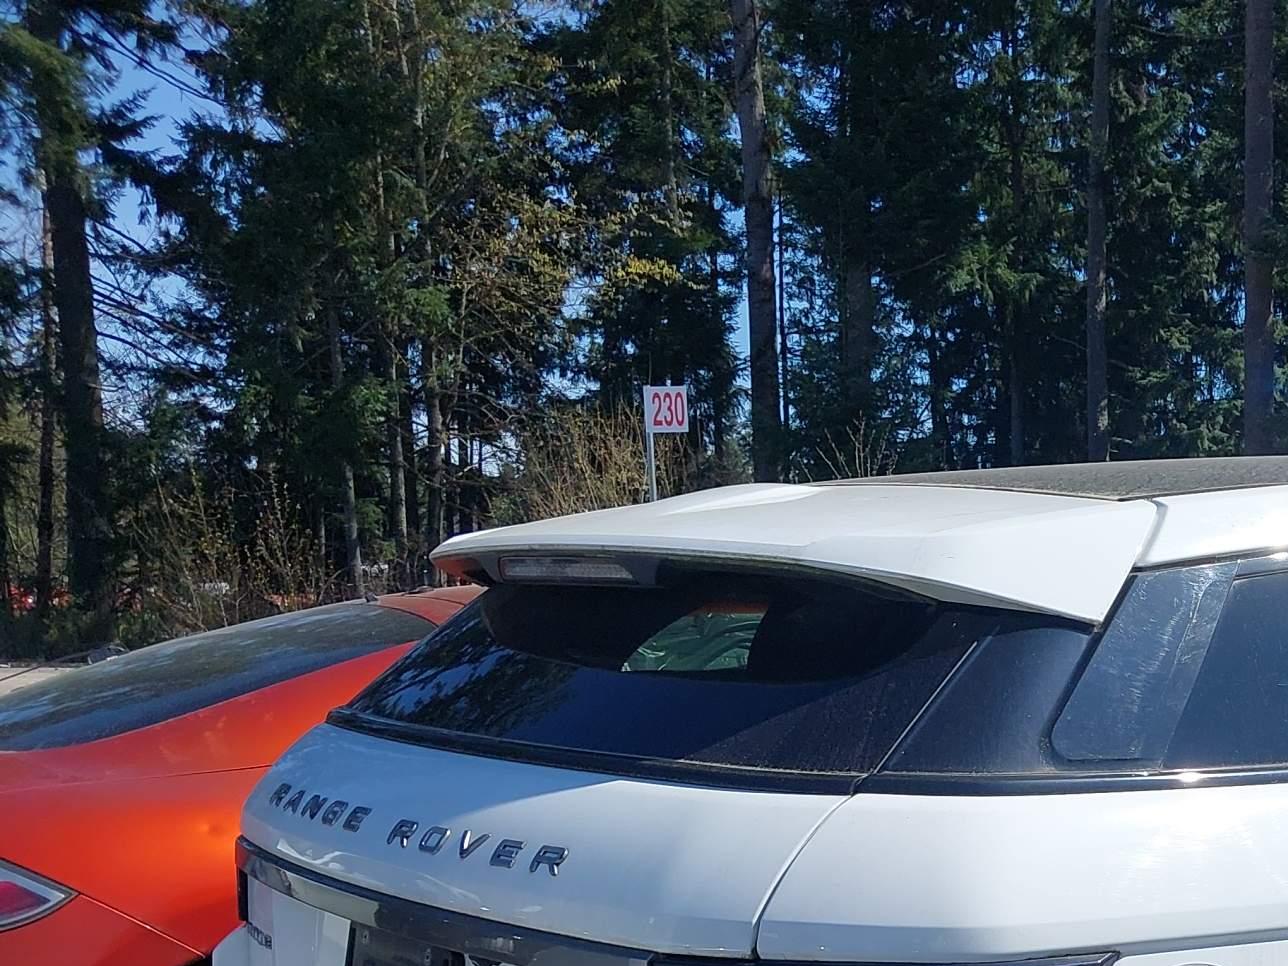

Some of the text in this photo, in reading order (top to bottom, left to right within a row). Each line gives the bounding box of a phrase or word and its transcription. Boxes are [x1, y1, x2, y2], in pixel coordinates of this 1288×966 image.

[651, 391, 686, 427] 230
[268, 782, 570, 877] RANGE ROVER
